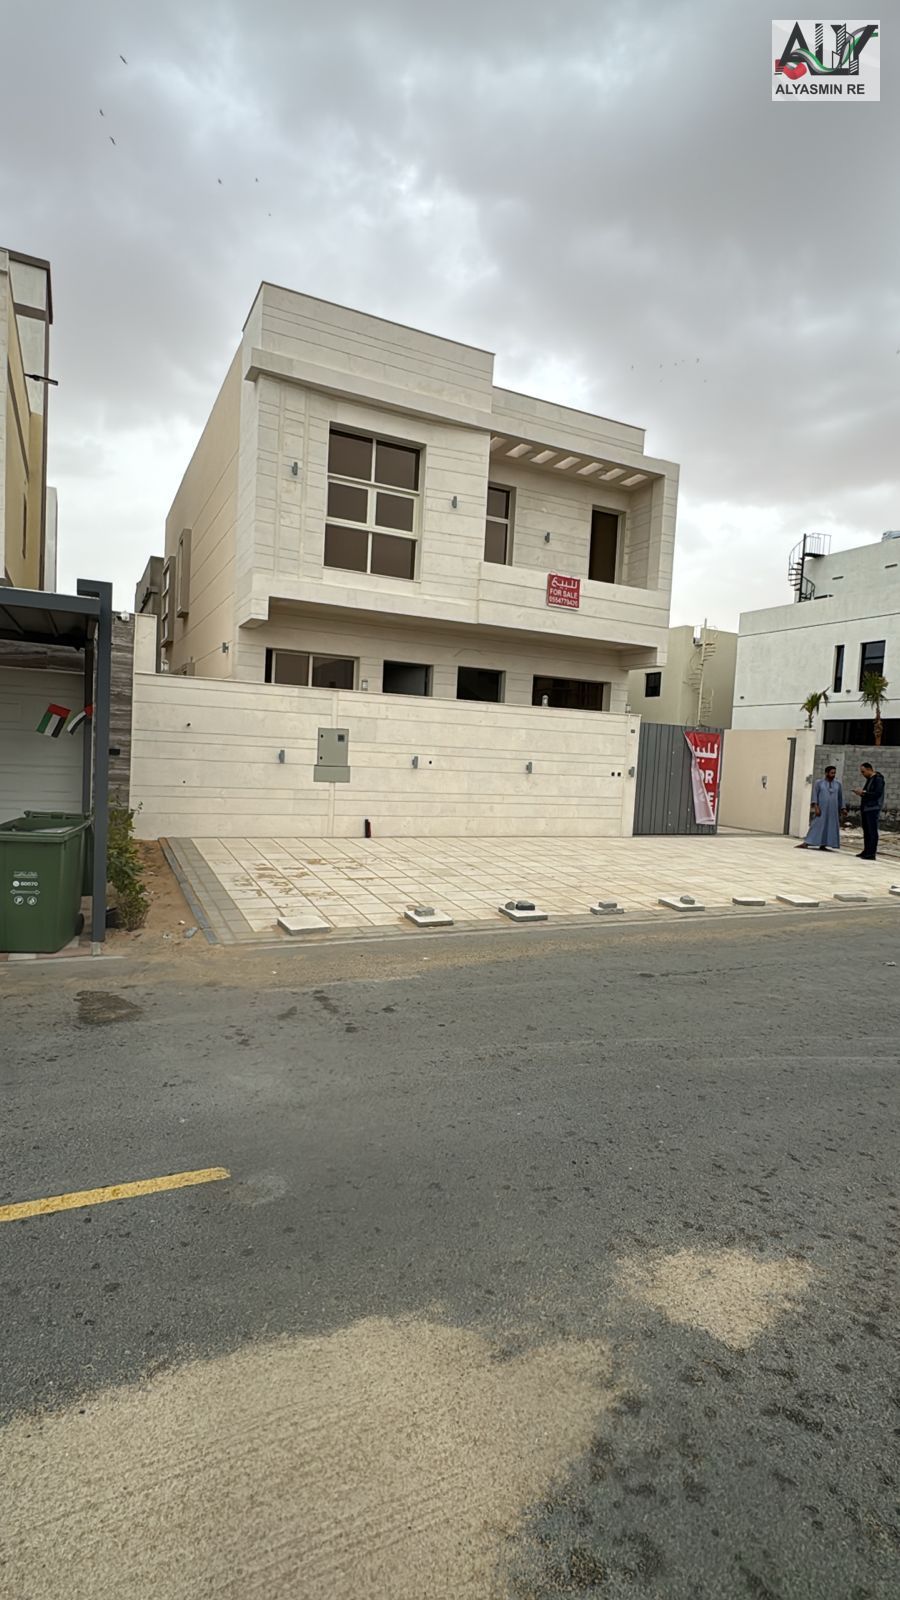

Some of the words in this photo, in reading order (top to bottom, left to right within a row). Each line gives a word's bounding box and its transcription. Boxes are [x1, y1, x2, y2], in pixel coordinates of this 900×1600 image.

[551, 576, 578, 590] للبيع
[550, 587, 562, 597] FOR
[563, 590, 578, 600] SALE
